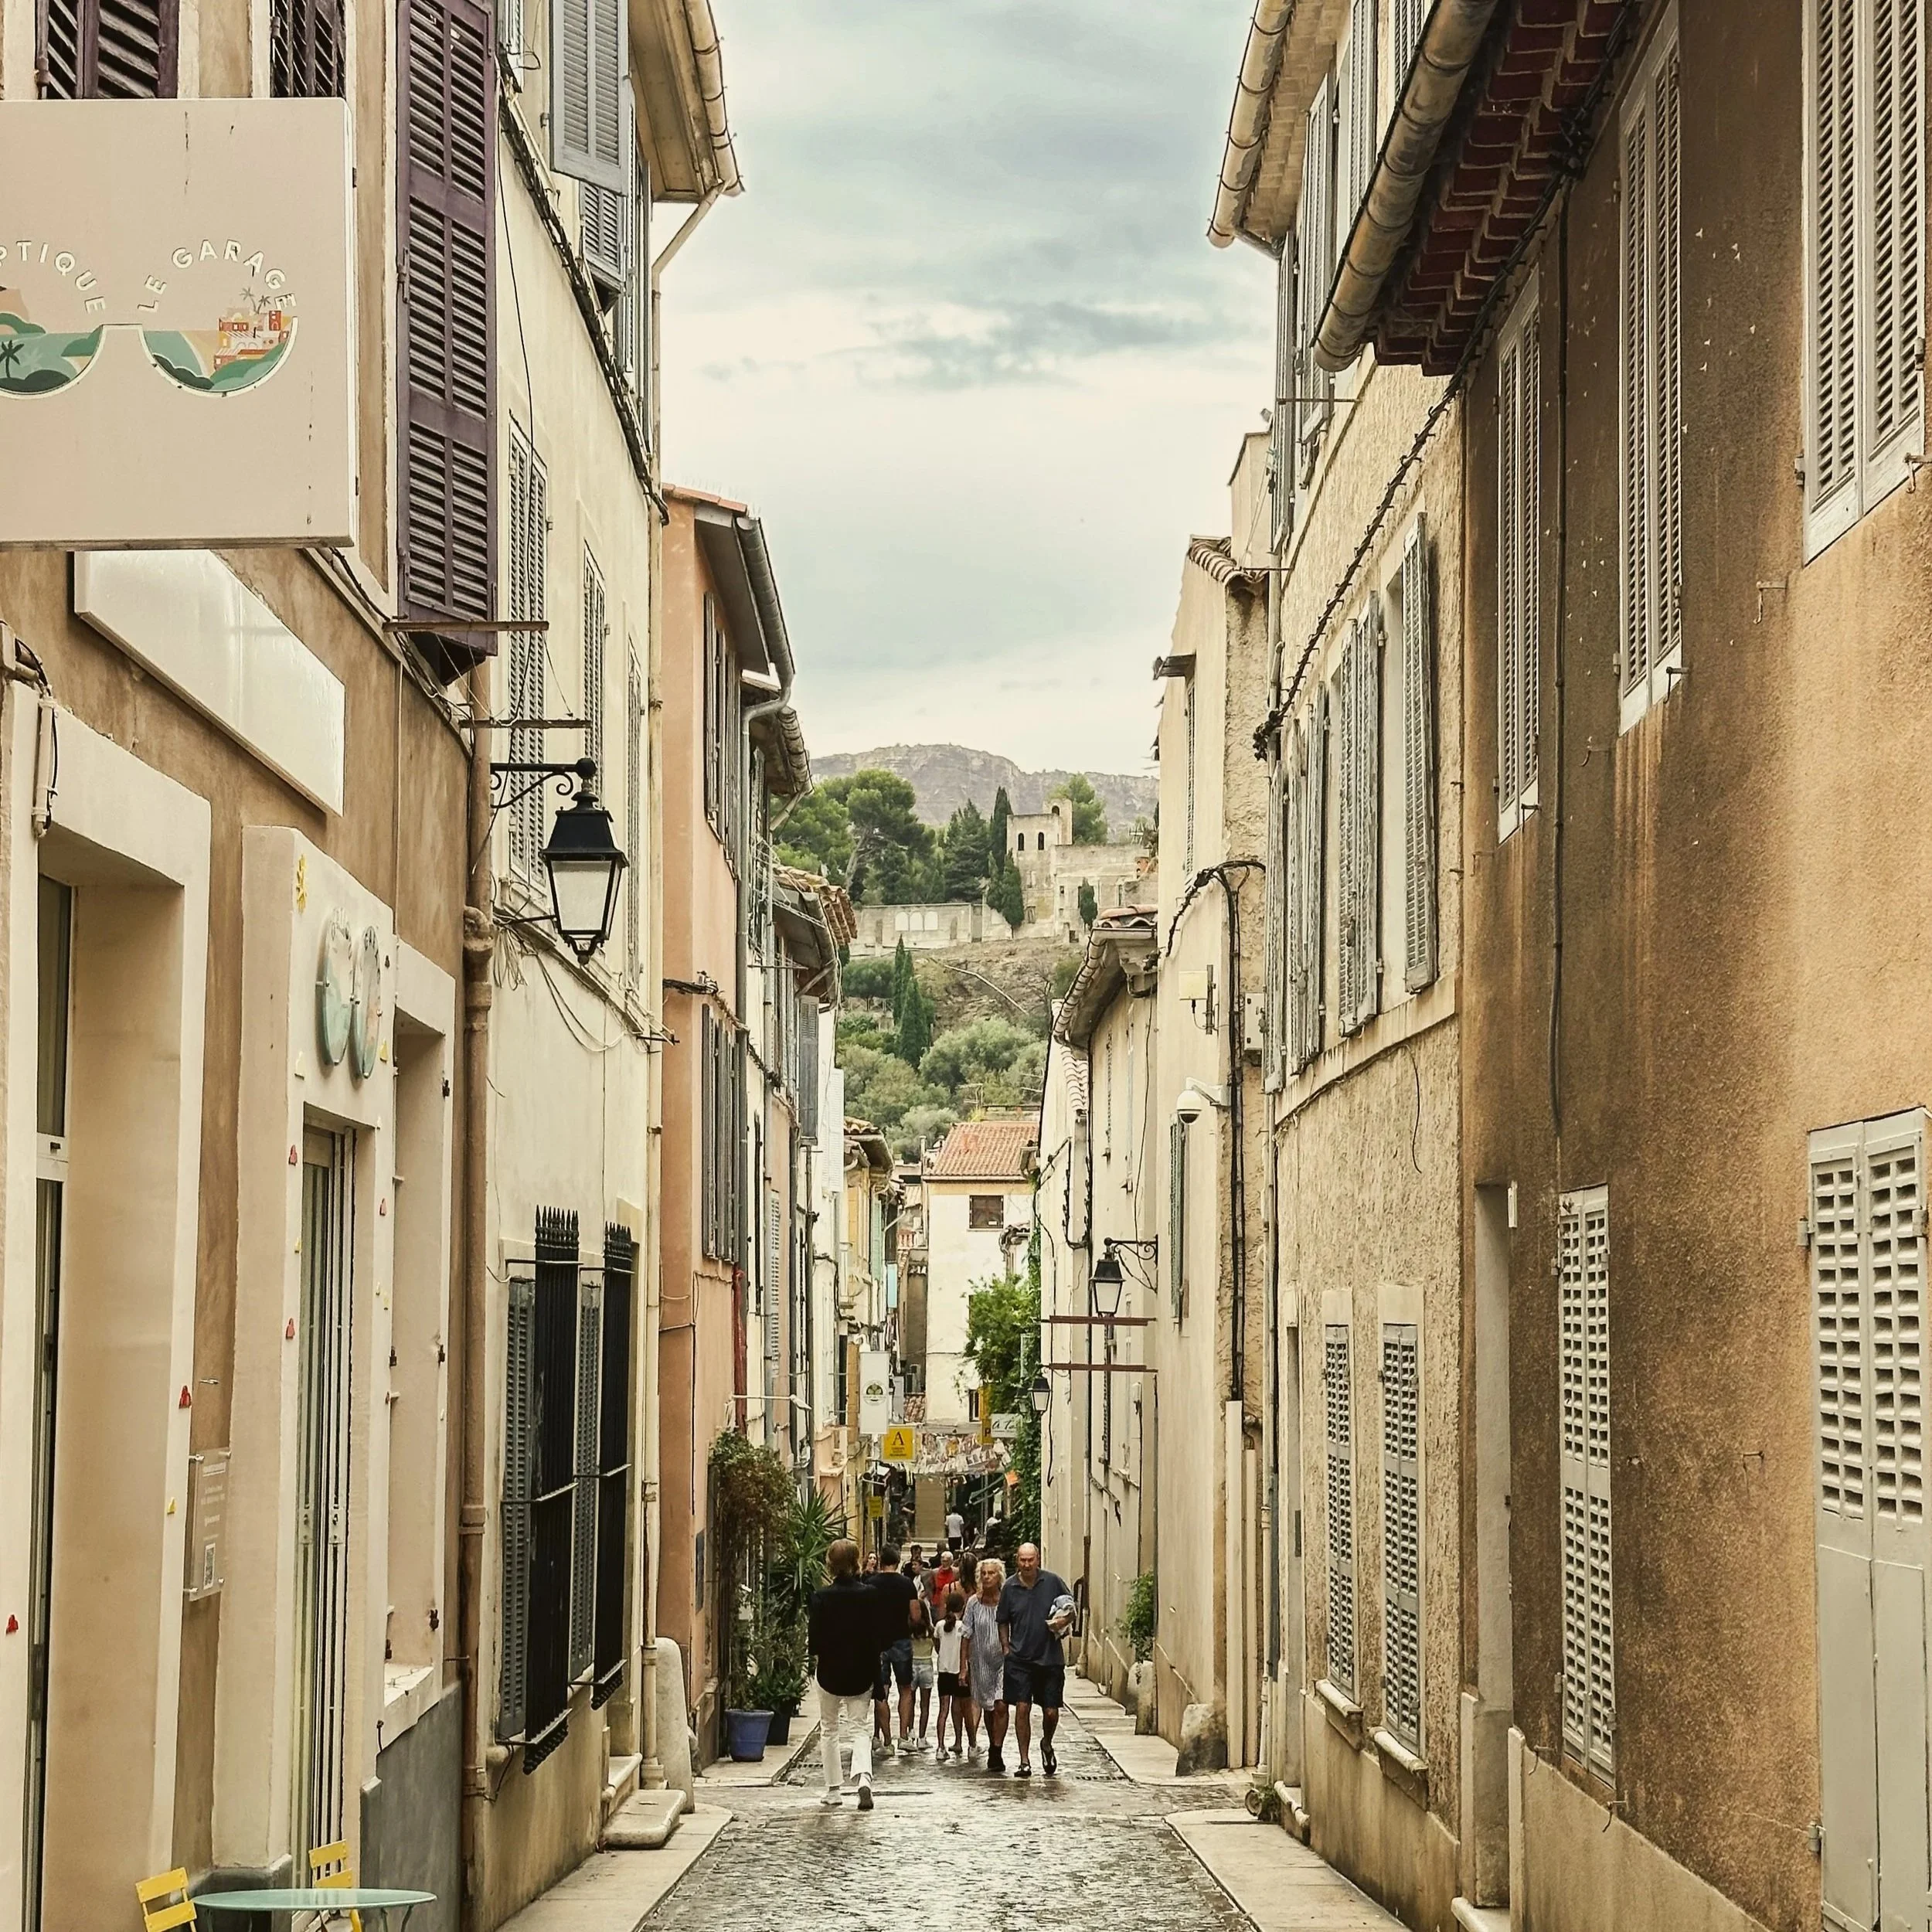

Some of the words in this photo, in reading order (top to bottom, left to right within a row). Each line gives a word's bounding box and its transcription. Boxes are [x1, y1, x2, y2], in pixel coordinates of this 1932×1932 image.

[138, 274, 167, 312] LE
[172, 239, 297, 310] GARAGE
[892, 1431, 904, 1445] A
